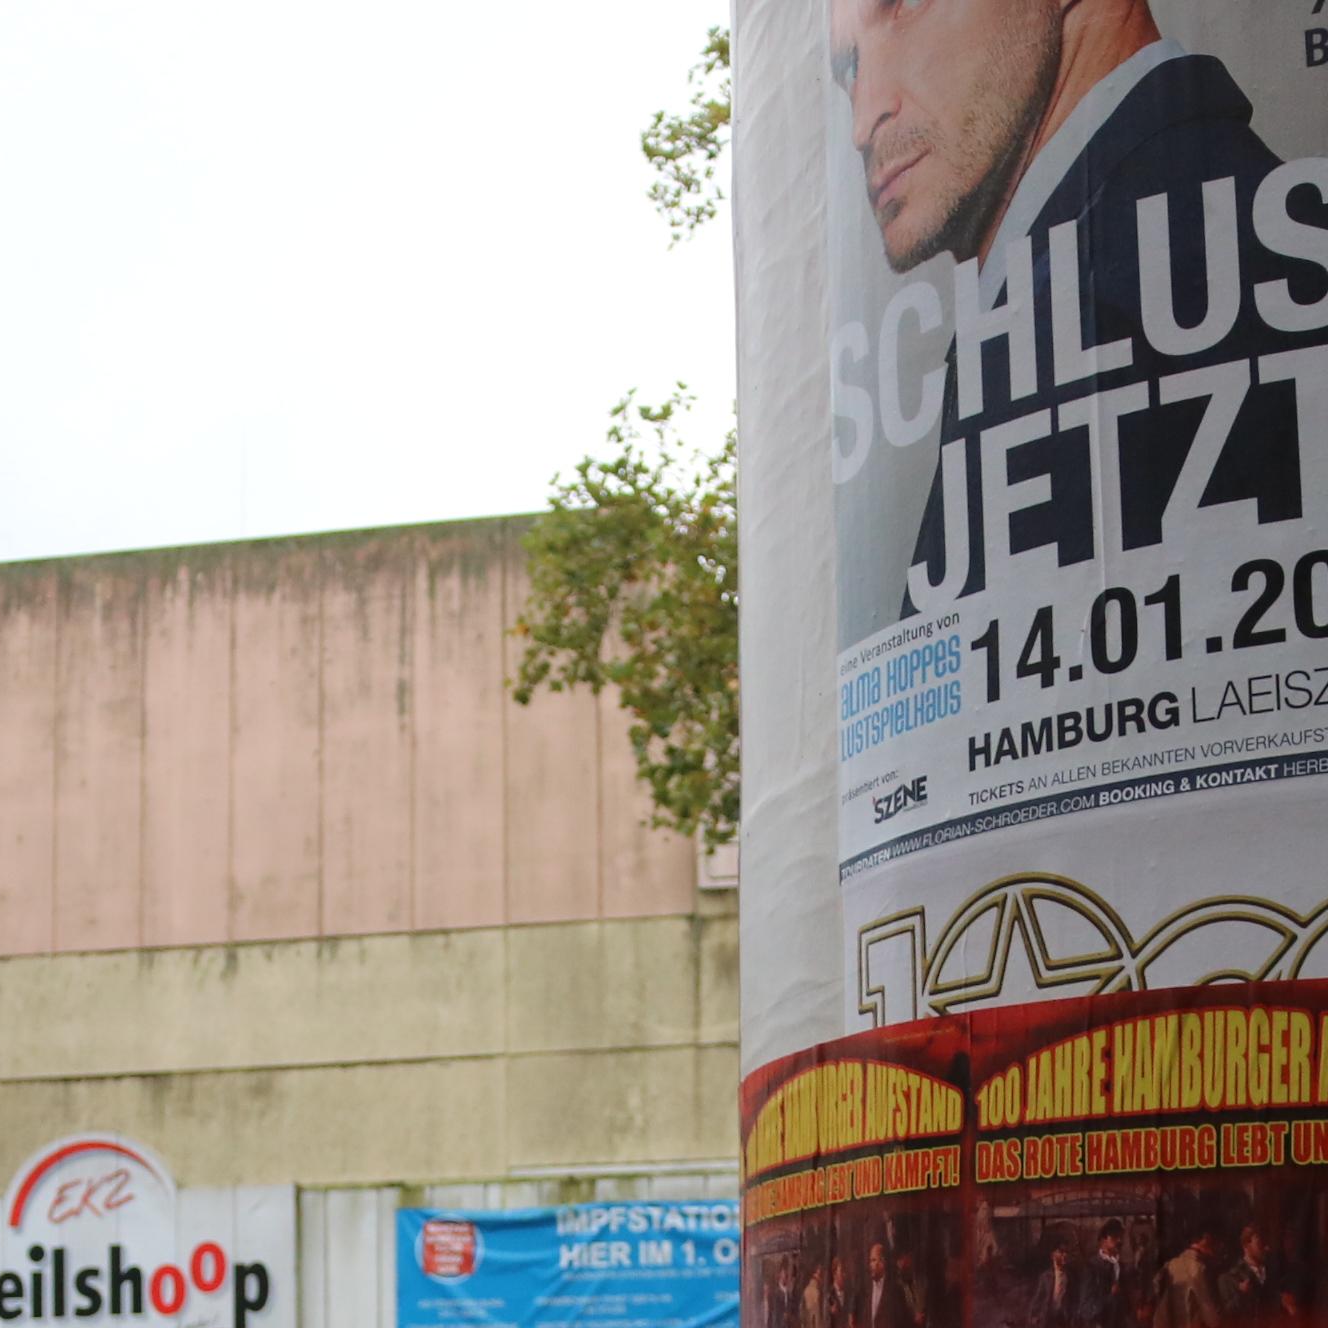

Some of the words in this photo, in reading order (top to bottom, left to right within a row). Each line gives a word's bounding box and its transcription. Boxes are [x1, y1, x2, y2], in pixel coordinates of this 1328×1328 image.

[840, 656, 858, 676] eine
[860, 620, 934, 662] Veranstaltung
[936, 612, 960, 632] von
[968, 690, 1180, 773] HAMBURG
[968, 780, 1025, 806] TICKETS
[1028, 775, 1048, 791] AN
[1051, 764, 1097, 787] ALLEN
[1100, 746, 1196, 778] BEKANNTEN
[1099, 779, 1176, 807] BOOKING
[1179, 776, 1191, 791] &
[1195, 764, 1279, 790] KONTAKT
[976, 1063, 1022, 1128] 100
[1023, 1029, 1108, 1122] JAHRE
[1112, 1008, 1314, 1115] HAMBURGER
[865, 1063, 963, 1146] AUFSTAND
[852, 1156, 882, 1198] UND
[883, 1144, 961, 1194] KÄMPFT!
[976, 1138, 1022, 1183] DAS
[1023, 1134, 1083, 1178] ROTE
[1084, 1124, 1217, 1176] HAMBURG
[1221, 1121, 1290, 1168] LEBT
[47, 1168, 135, 1226] EKZ
[558, 1240, 632, 1270] HIER
[639, 1239, 671, 1266] IM
[680, 1239, 707, 1267] 1.
